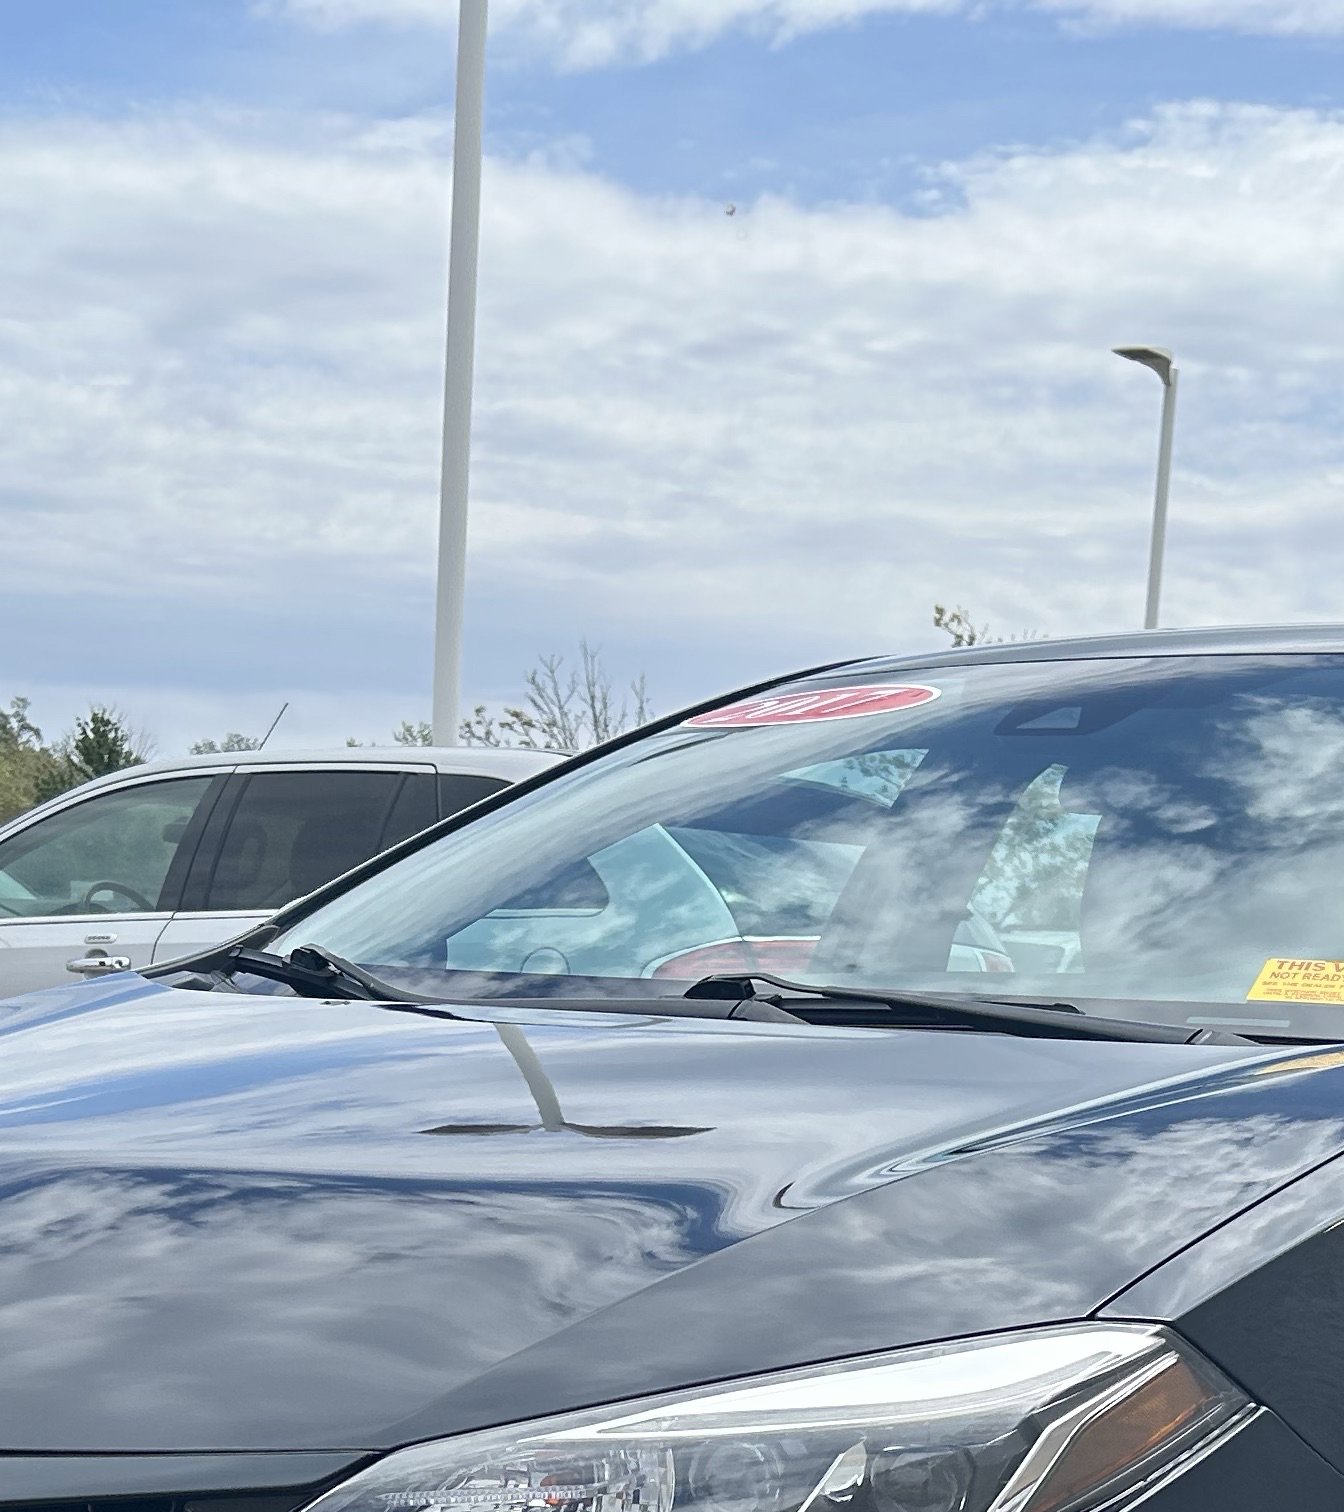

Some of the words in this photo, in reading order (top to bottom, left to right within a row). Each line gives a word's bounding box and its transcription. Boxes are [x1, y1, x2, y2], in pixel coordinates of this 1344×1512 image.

[701, 689, 910, 724] 2017
[1277, 960, 1326, 972] THIS
[1269, 972, 1299, 980] NOT
